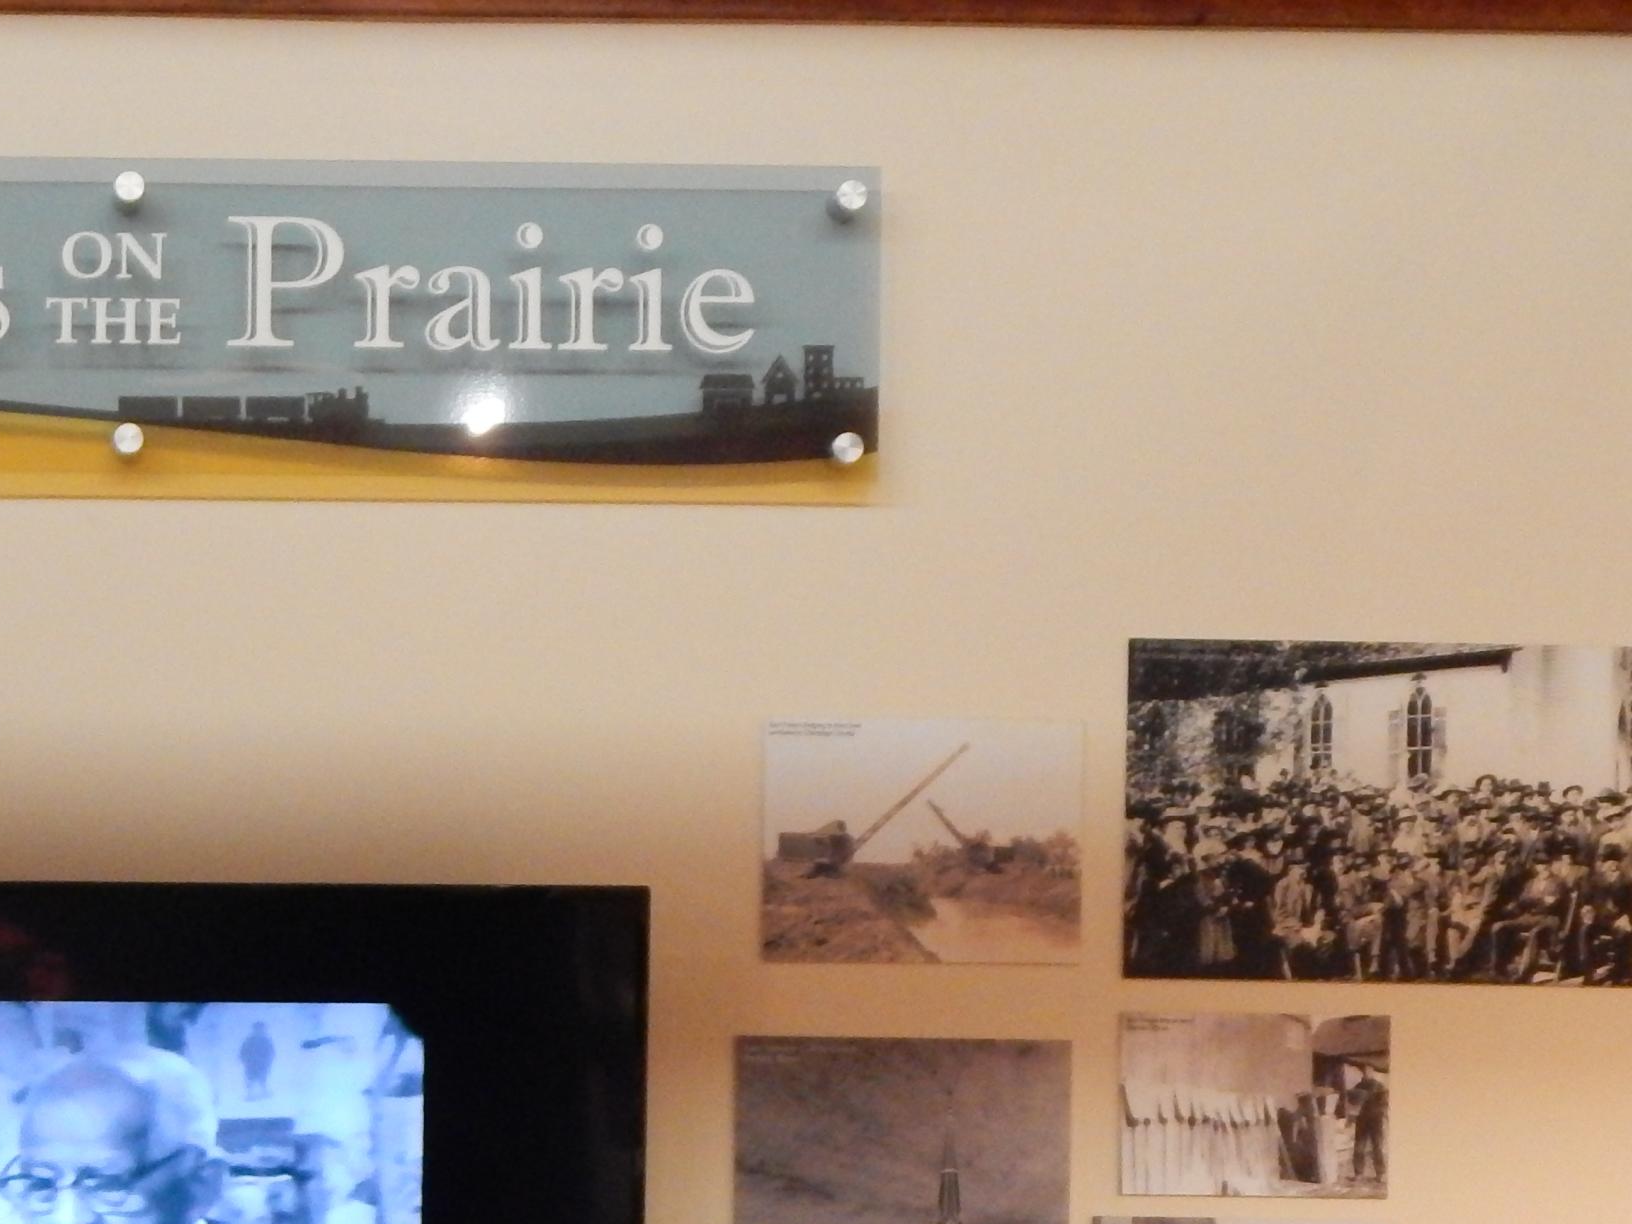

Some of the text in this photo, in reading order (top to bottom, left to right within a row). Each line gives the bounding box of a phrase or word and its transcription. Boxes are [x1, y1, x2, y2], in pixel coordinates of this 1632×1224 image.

[62, 230, 167, 280] ON
[226, 215, 756, 354] Prairie
[45, 296, 182, 346] THE
